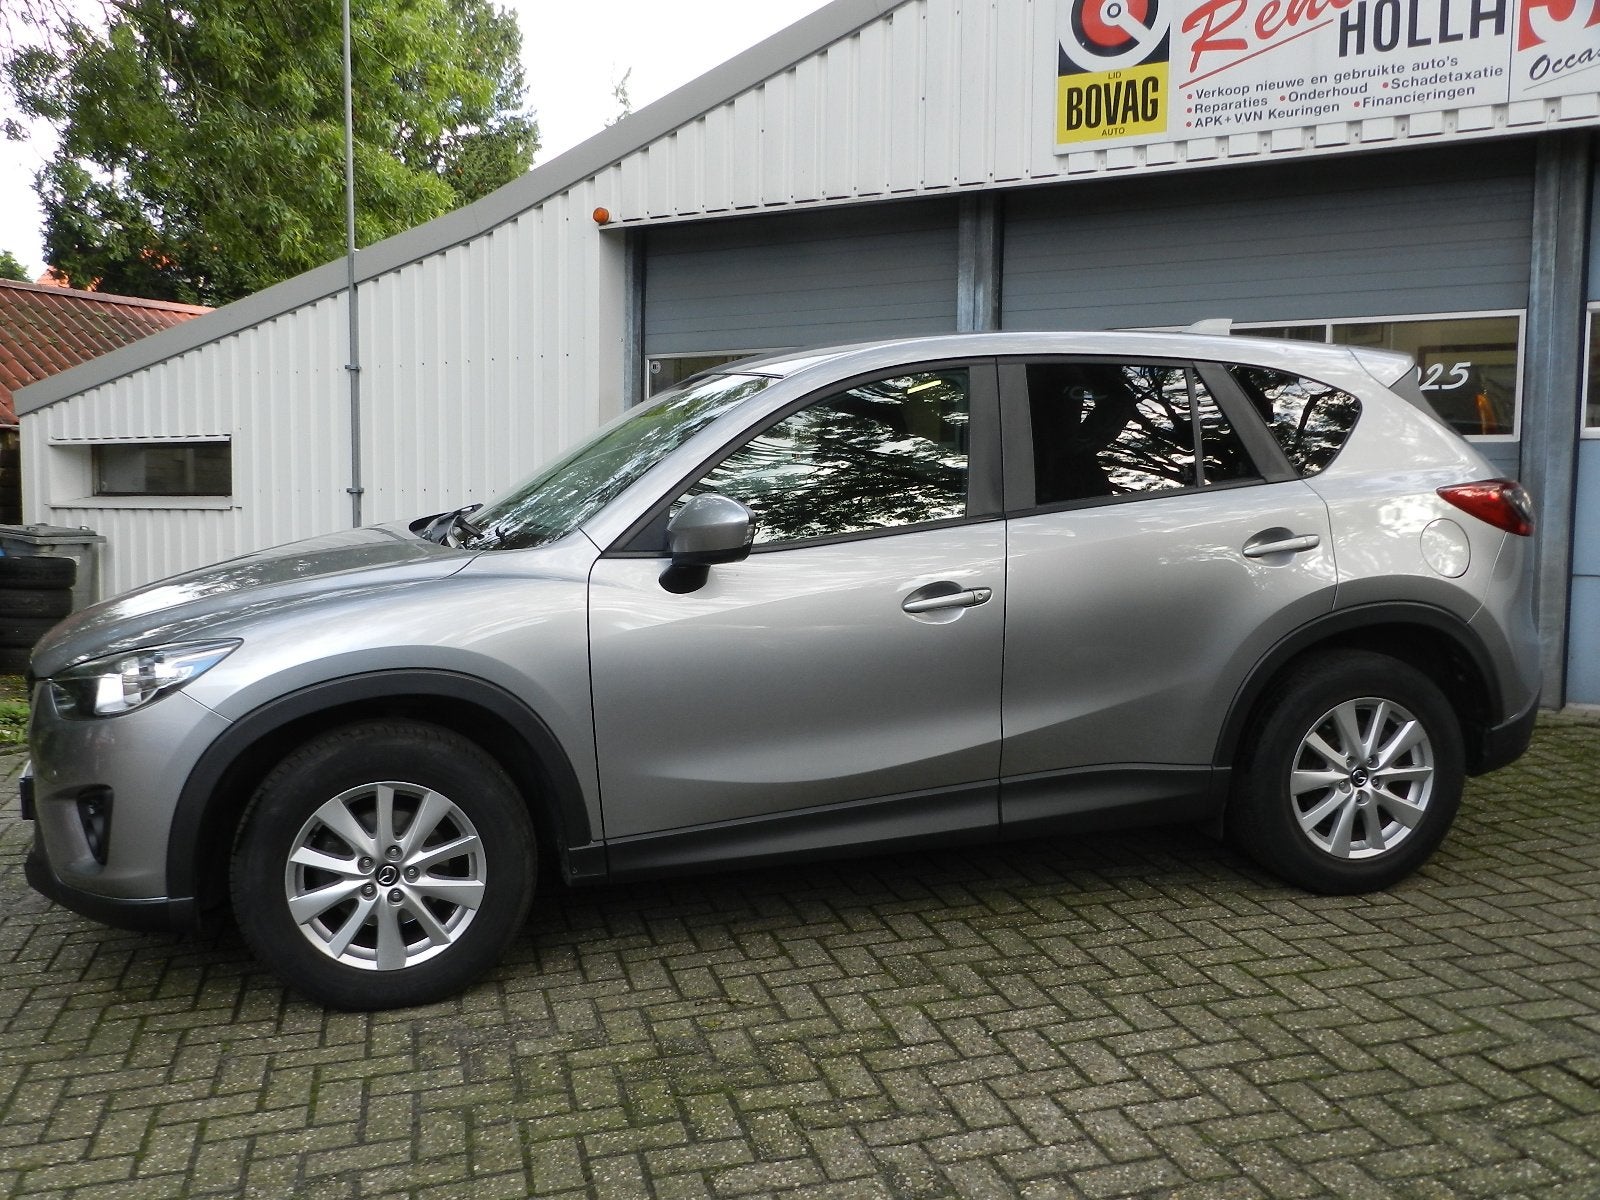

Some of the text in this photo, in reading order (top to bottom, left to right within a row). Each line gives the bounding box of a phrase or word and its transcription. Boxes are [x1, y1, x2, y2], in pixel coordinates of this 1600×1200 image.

[1181, 0, 1352, 73] Ren
[1107, 71, 1122, 80] LID
[1194, 66, 1503, 115] Reparaties Onderhoud Schadetaxatie
[1195, 56, 1459, 99] Verkoop nieuwe en gebruikte auto's
[1066, 76, 1159, 131] BOVAG
[1268, 102, 1340, 120] Keuringen
[1362, 86, 1476, 109] Financieringen
[1101, 127, 1125, 137] AUTO
